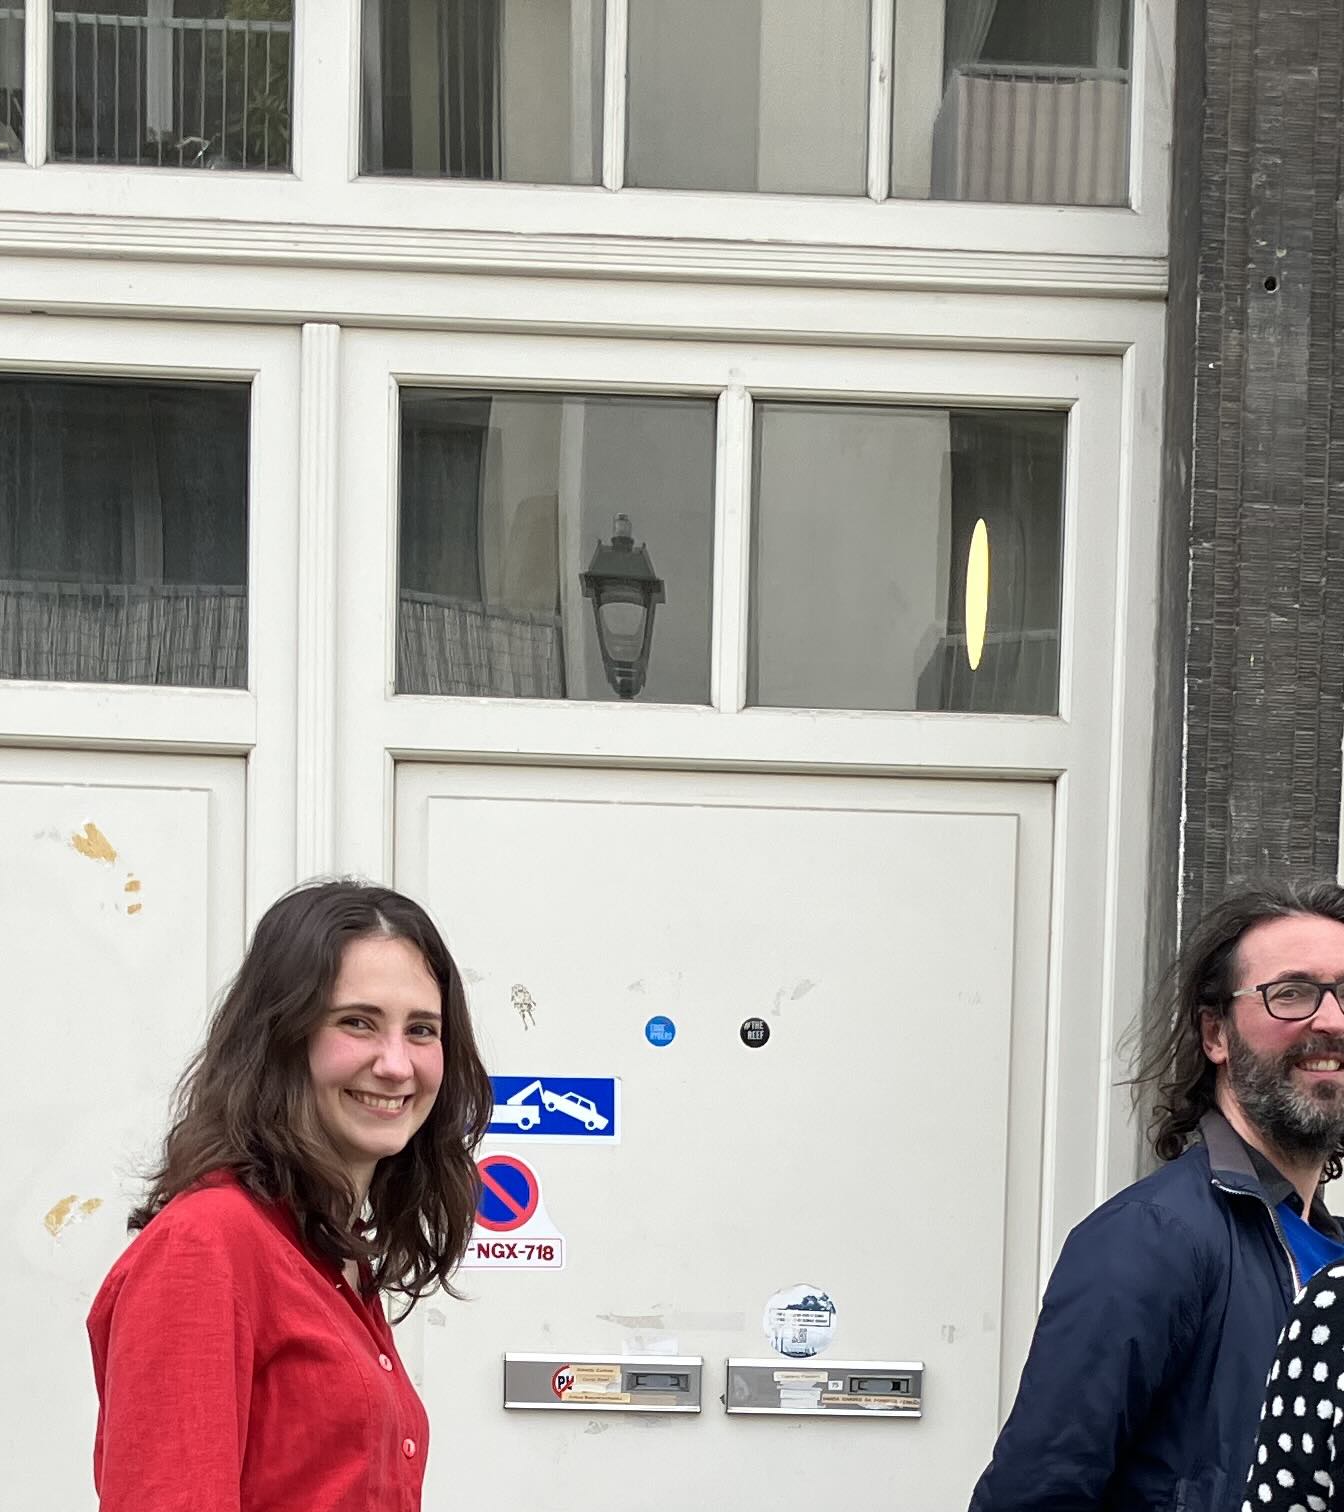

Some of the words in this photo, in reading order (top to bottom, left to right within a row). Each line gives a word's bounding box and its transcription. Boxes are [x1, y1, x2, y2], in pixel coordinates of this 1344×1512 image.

[744, 1021, 764, 1030] #THE
[747, 1031, 764, 1040] REEF
[467, 1243, 555, 1261] -NGX-718
